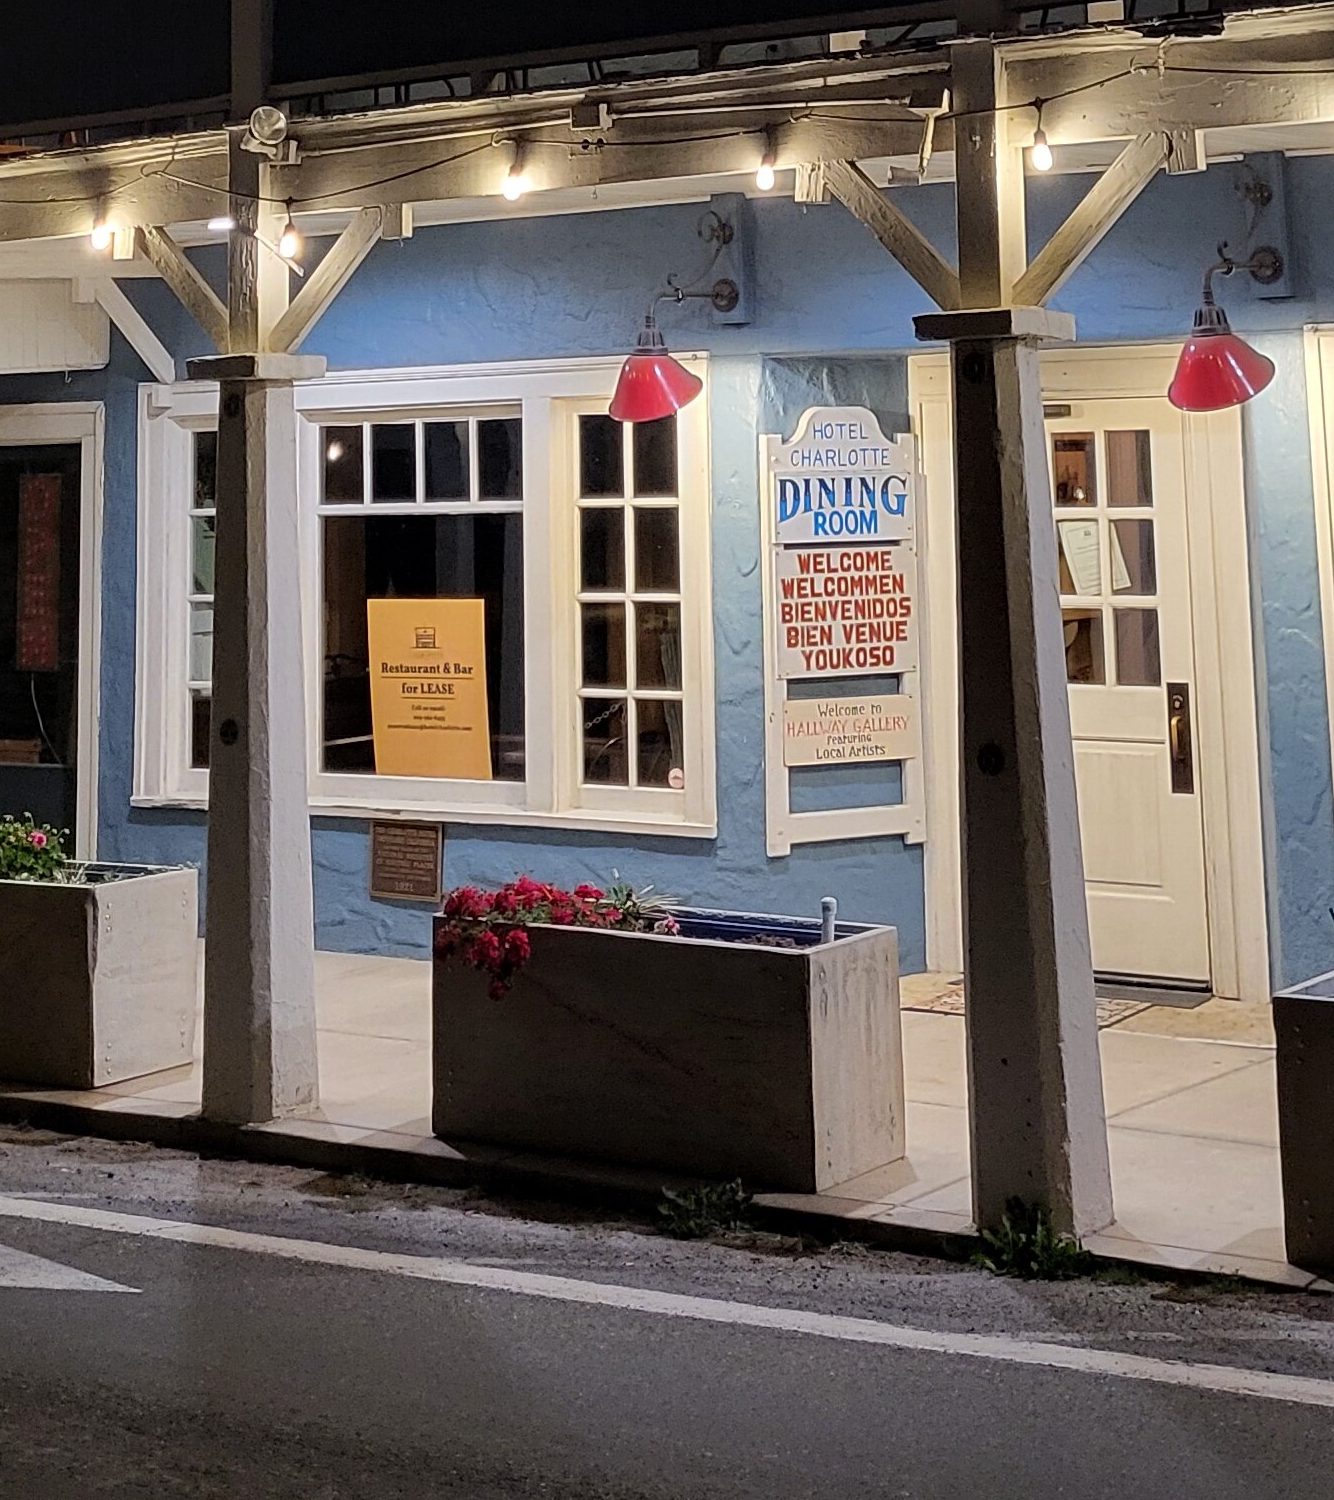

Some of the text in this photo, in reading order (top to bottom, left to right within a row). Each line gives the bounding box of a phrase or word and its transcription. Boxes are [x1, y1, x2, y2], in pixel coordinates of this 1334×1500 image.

[812, 422, 869, 440] HOTEL
[790, 448, 891, 467] CHARLOTTE
[778, 475, 908, 523] DINING
[813, 509, 878, 536] ROOM
[797, 550, 893, 574] WELCOME
[781, 573, 904, 599] WELCOMMEN
[781, 596, 912, 624] BIENVENIDOS
[787, 620, 908, 648] BIEN VENUE
[381, 662, 474, 675] Restaurant & Bar
[801, 645, 895, 671] YOUKOSO
[401, 683, 455, 695] for LEASE
[817, 703, 882, 717] Welcome to
[787, 715, 910, 738] HALLWAY GALLERY
[827, 733, 872, 746] featuring
[816, 744, 886, 760] Local Artists
